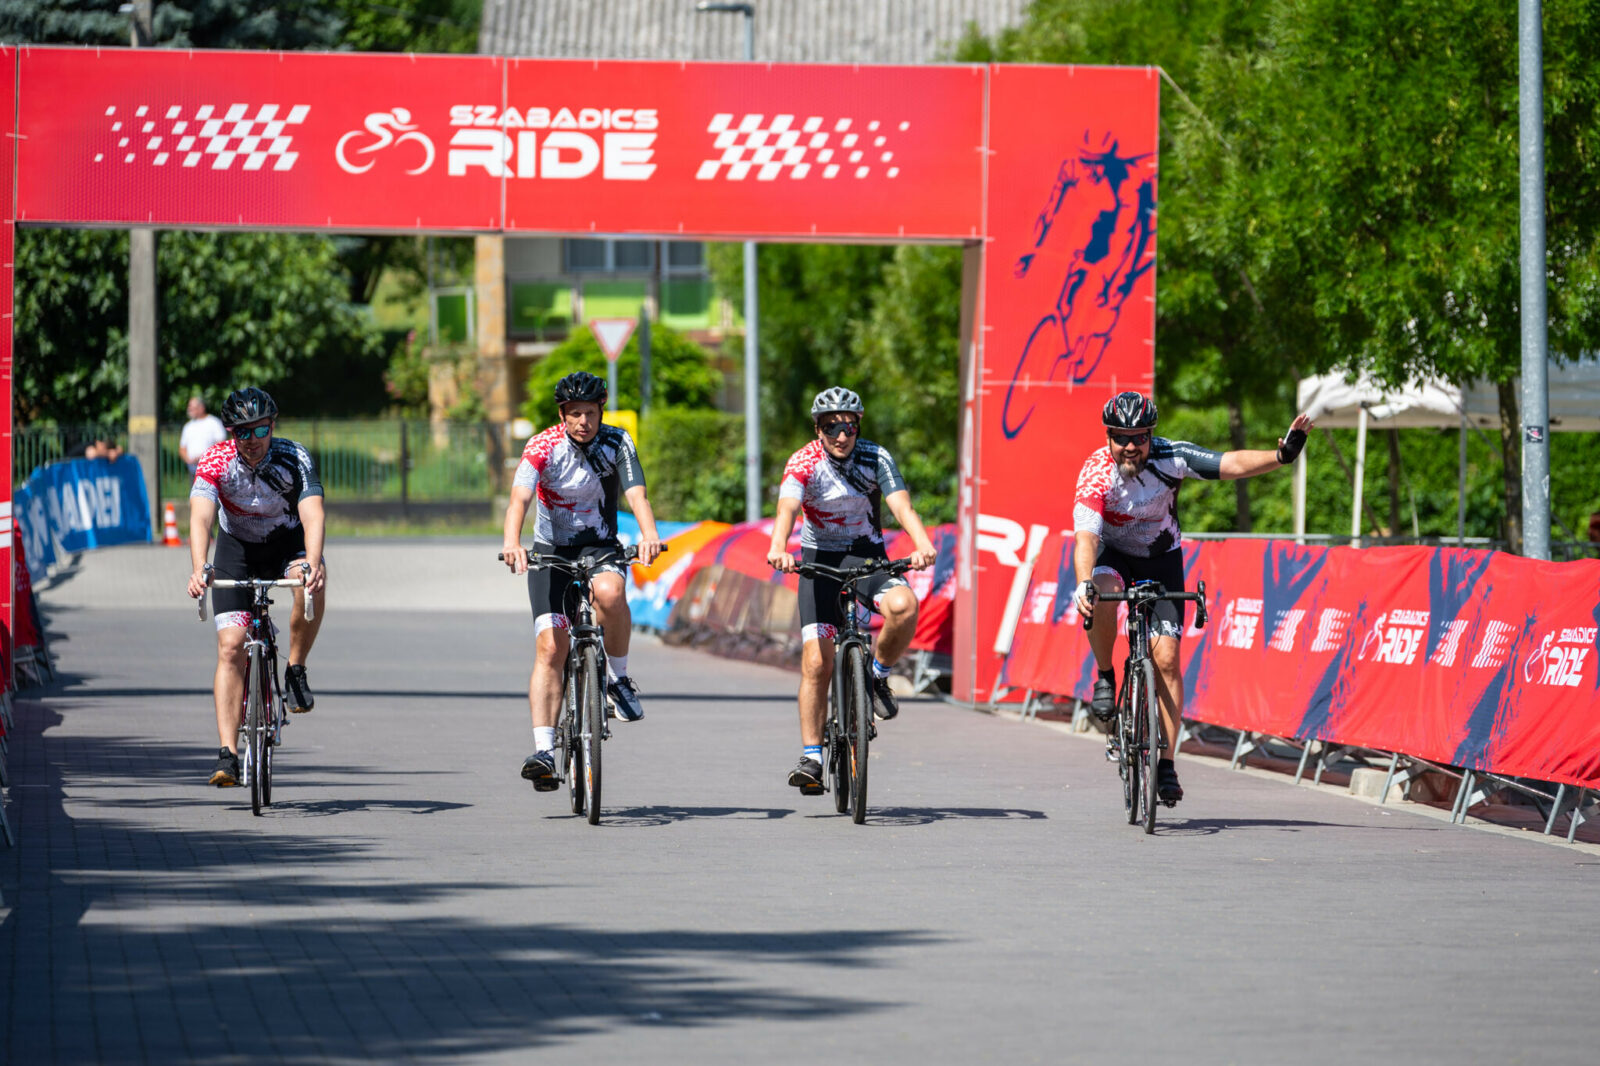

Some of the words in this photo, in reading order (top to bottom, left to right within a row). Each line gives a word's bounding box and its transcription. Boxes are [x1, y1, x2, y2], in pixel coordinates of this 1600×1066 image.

[449, 105, 659, 131] SZABADICS
[448, 128, 658, 181] RIDE
[1376, 627, 1425, 665] RIDE
[1542, 646, 1590, 687] RIDE
